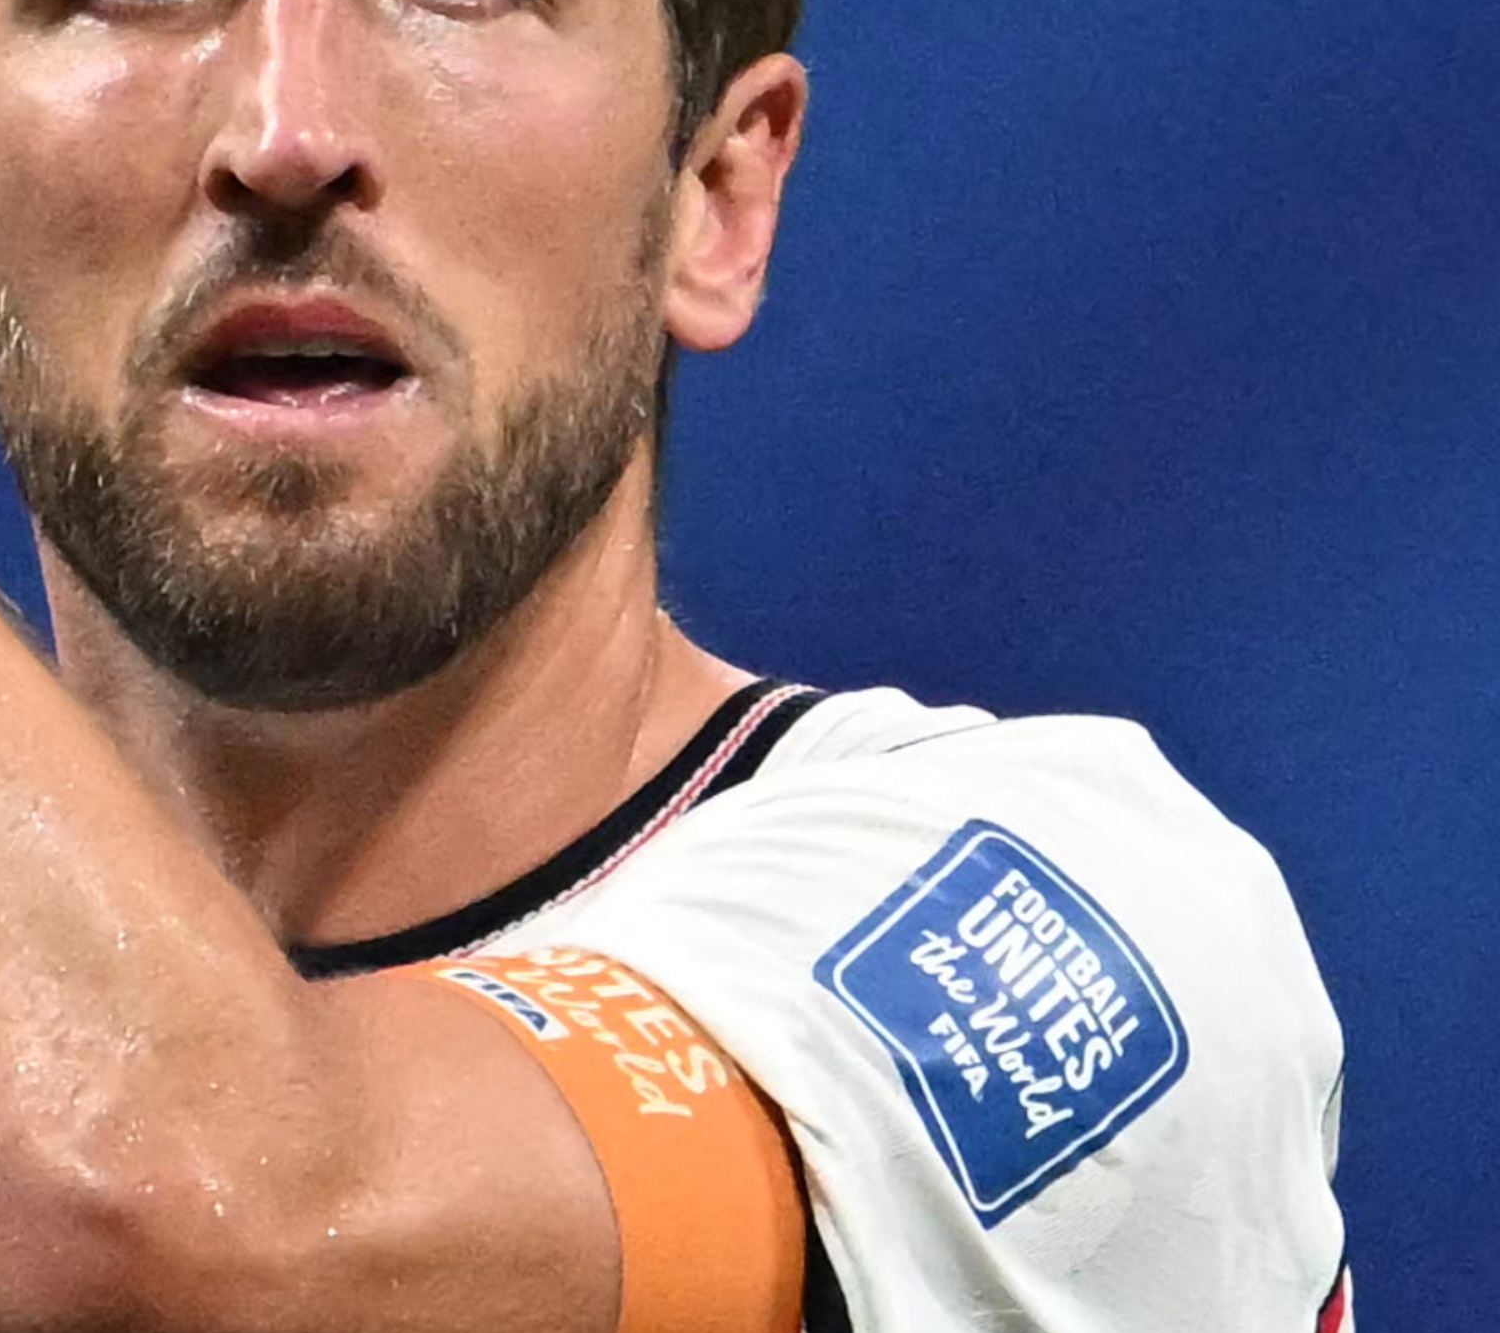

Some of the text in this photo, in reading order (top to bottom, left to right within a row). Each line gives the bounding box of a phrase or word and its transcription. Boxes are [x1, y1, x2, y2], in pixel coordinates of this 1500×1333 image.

[452, 970, 549, 1033] FIFA
[910, 929, 1074, 1139] the World
[928, 1012, 989, 1104] FIFA
[957, 894, 1113, 1091] UNITES
[992, 868, 1140, 1058] FOOTBALL
